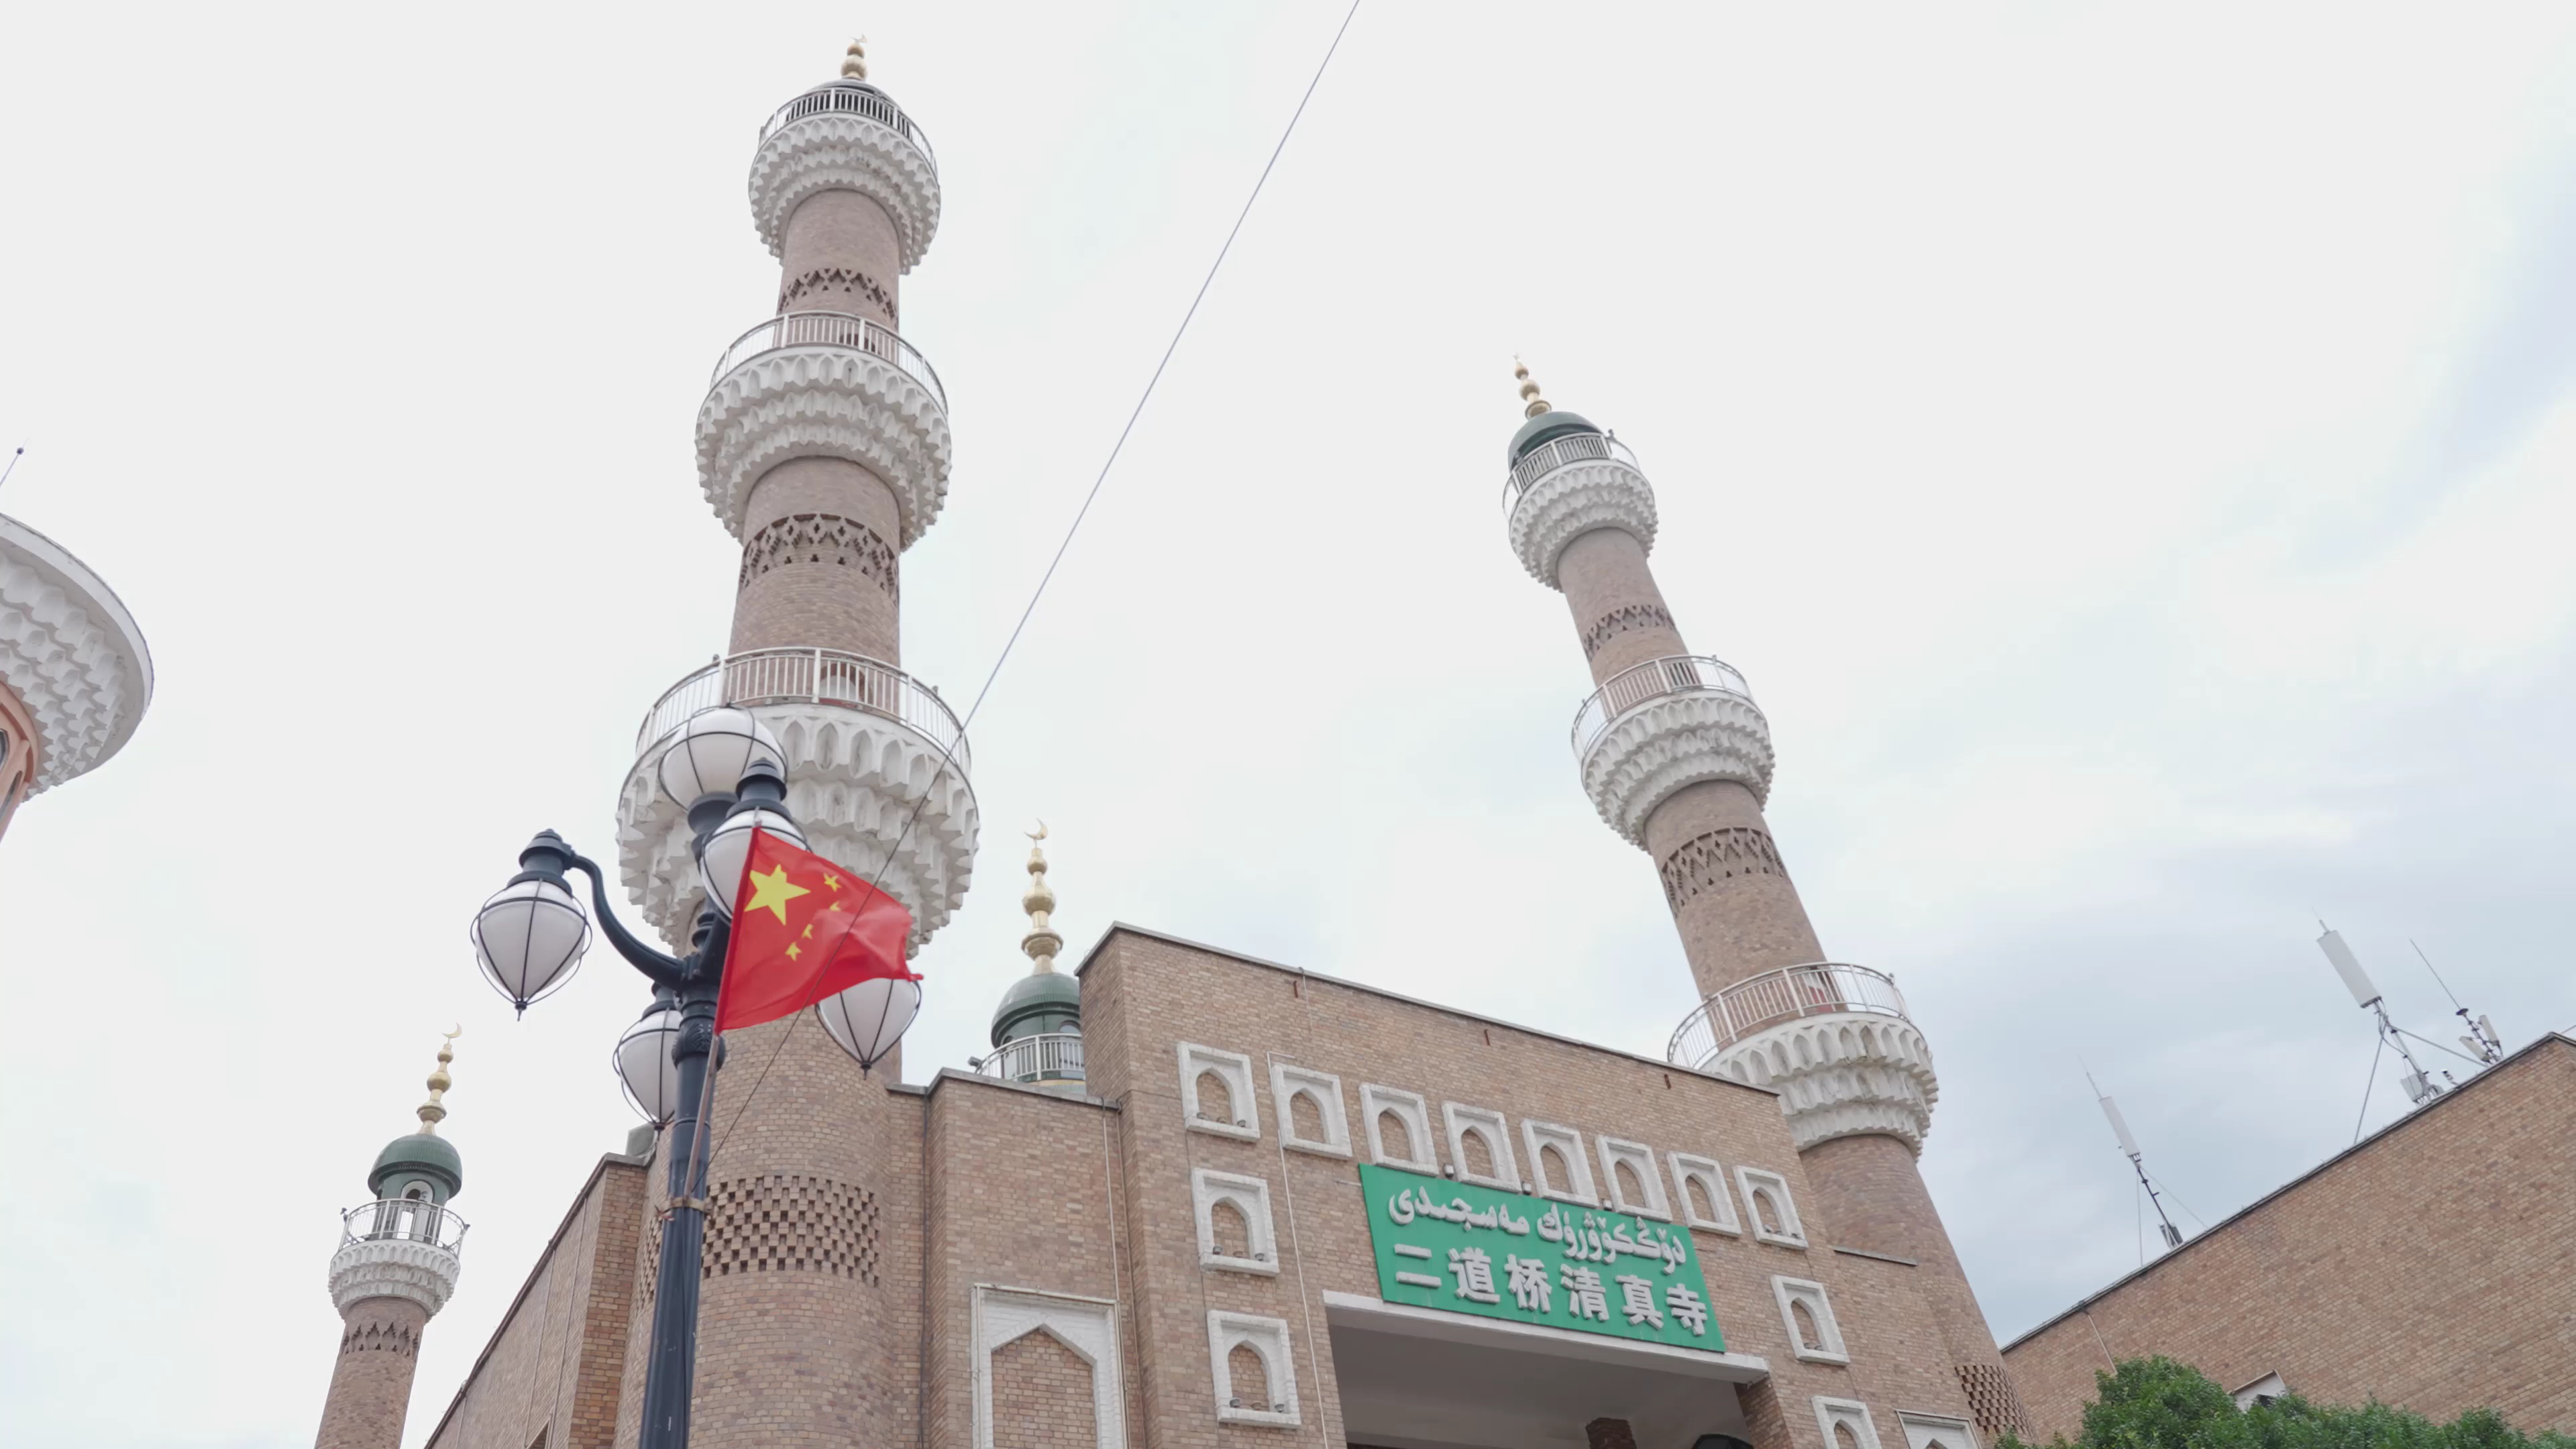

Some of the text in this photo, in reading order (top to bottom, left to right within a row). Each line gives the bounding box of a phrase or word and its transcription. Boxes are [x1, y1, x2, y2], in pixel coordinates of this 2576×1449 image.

[1394, 1243, 1707, 1336] 二道桥清真寺
